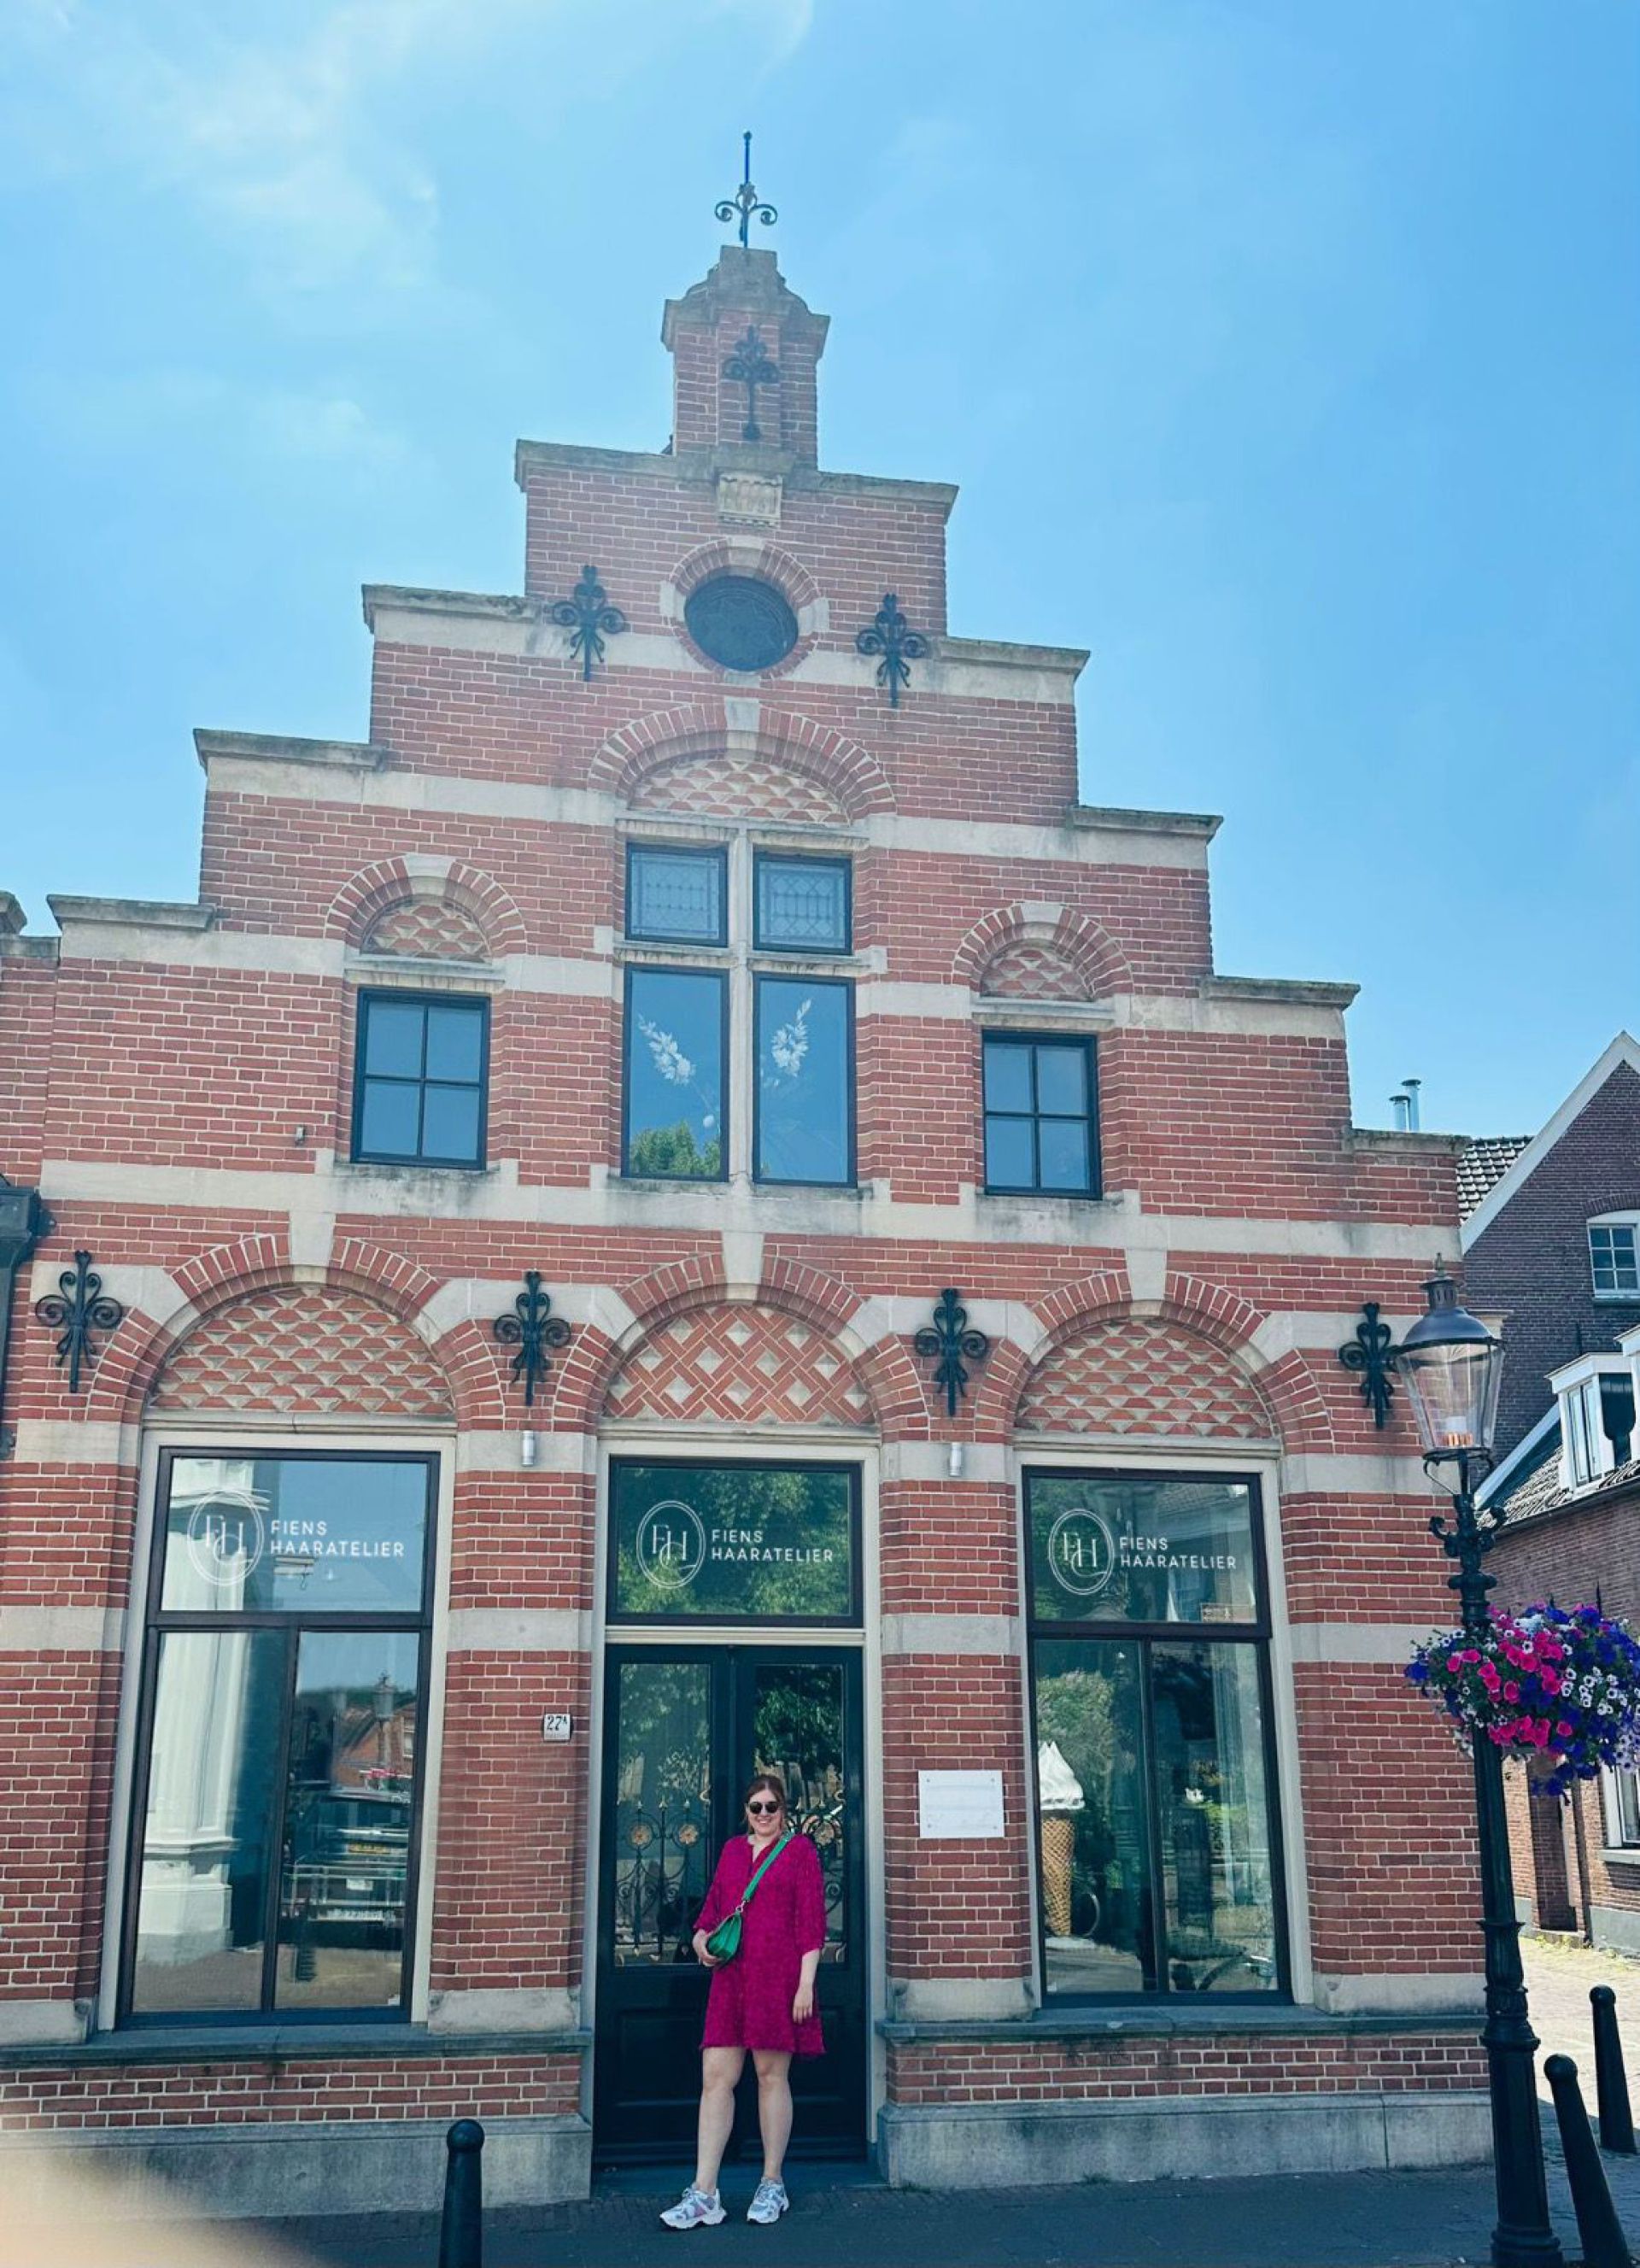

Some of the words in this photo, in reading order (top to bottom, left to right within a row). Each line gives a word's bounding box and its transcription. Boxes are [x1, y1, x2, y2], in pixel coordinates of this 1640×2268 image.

[270, 1520, 328, 1536] FIENS
[711, 1528, 764, 1544] FIENS
[270, 1540, 405, 1558] HAARATELIER
[1119, 1536, 1168, 1551] FIENS
[711, 1546, 834, 1562] HAARATELIER
[1121, 1554, 1237, 1570] HAARATELIER
